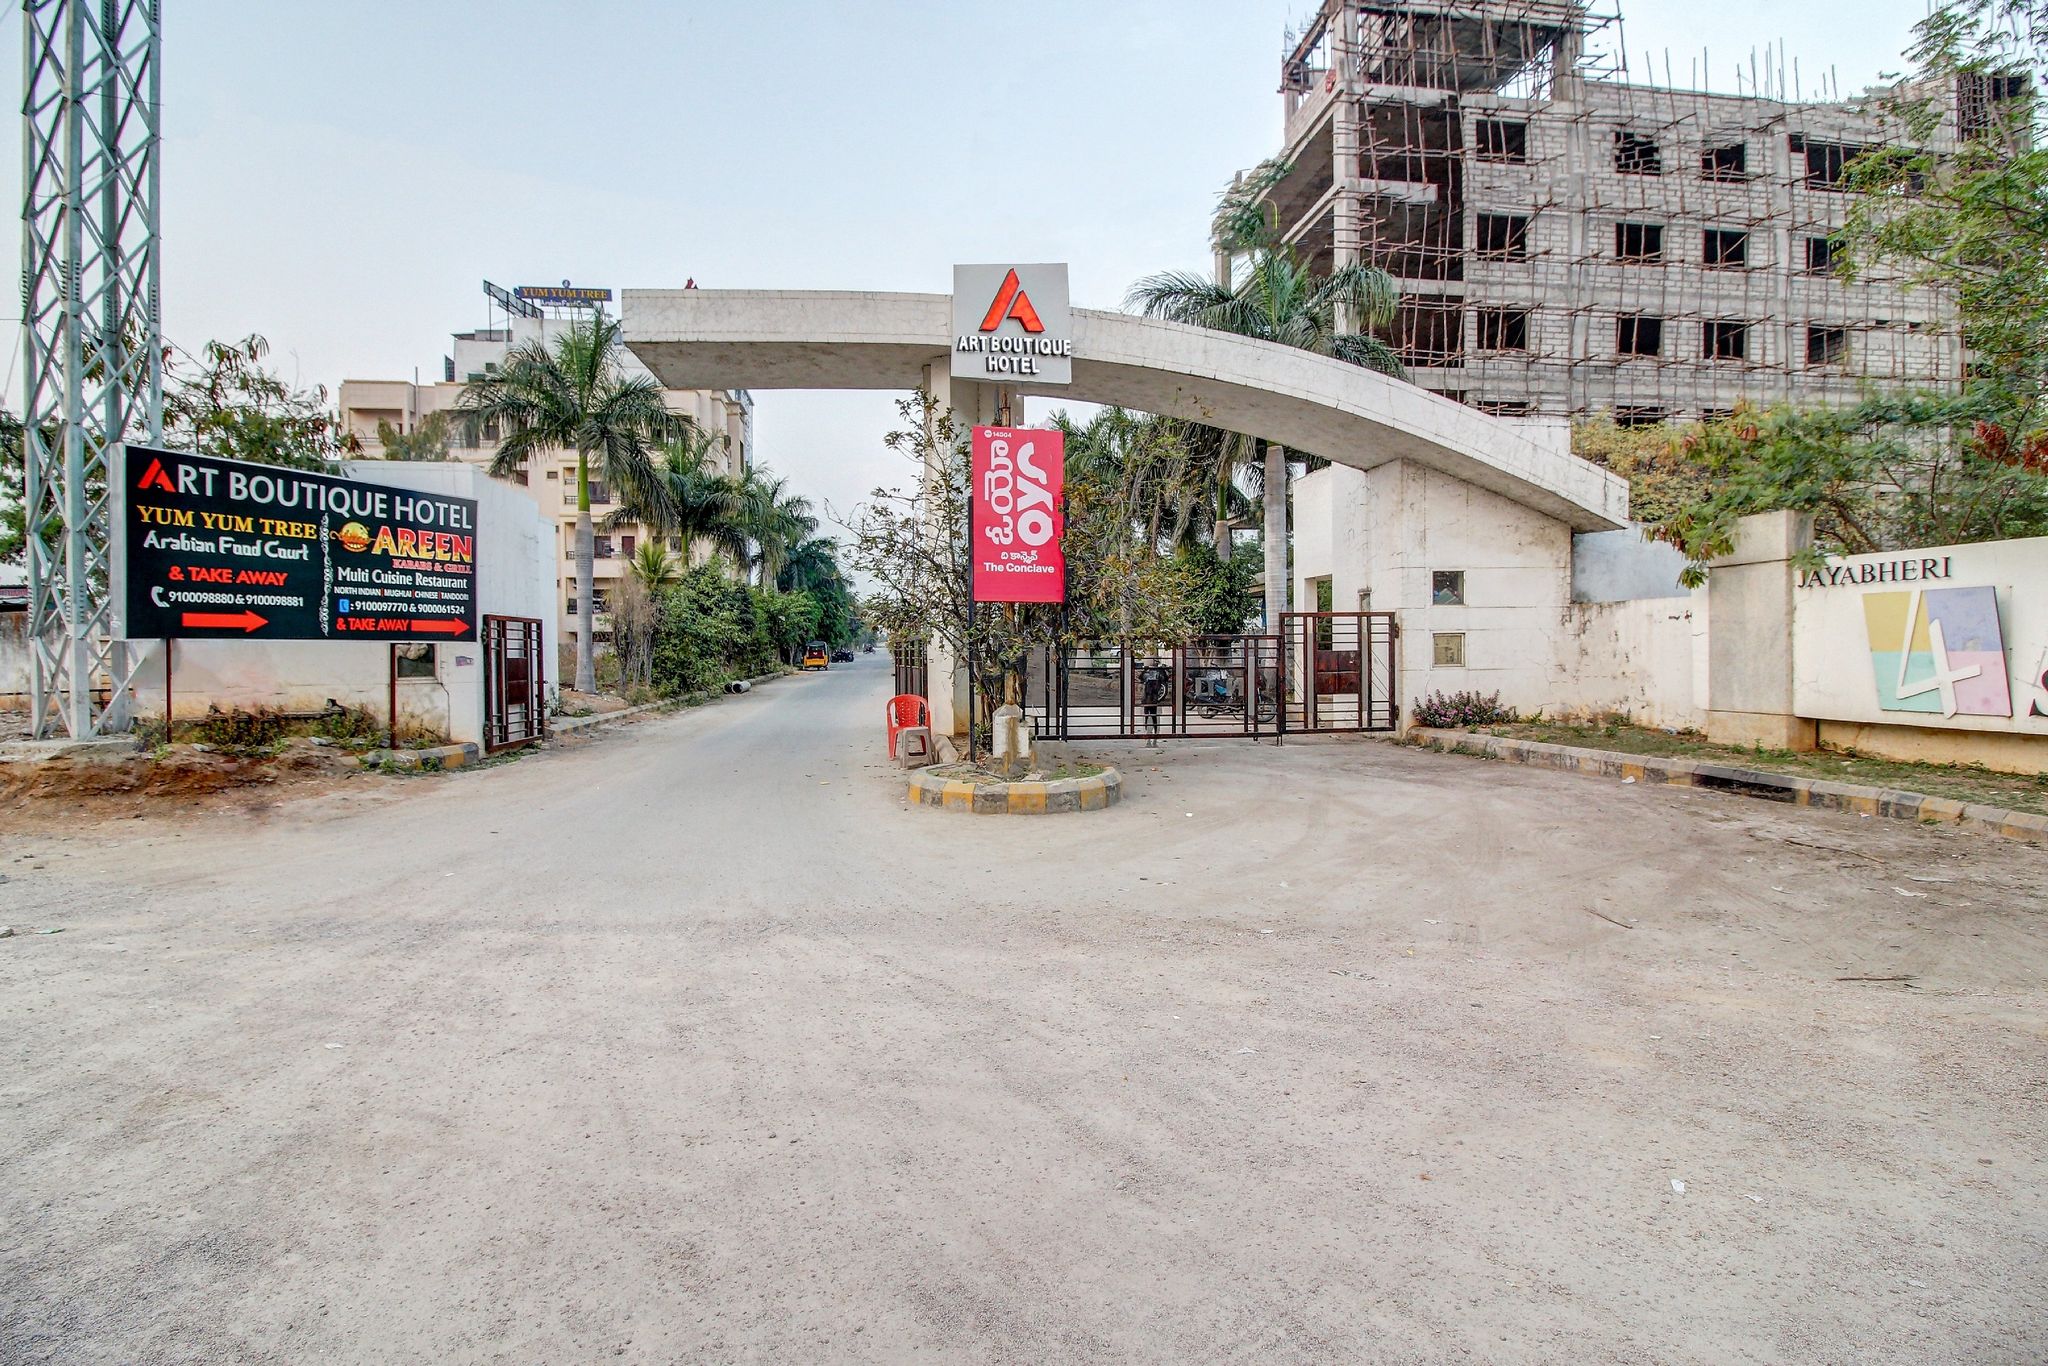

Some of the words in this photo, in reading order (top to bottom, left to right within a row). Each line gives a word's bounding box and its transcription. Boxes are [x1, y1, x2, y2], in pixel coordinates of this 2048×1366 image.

[522, 287, 548, 297] YUM
[550, 288, 577, 298] YUM
[578, 289, 607, 299] TREE
[957, 335, 987, 352] ART
[990, 337, 1071, 356] BOUTIQUE
[986, 355, 1040, 374] HOTEL
[137, 457, 219, 496] ART
[229, 471, 387, 518] BOUTIQUE
[395, 495, 473, 529] HOTEL
[136, 505, 195, 527] YUM
[200, 511, 254, 533] YUM
[259, 518, 317, 539] TREE
[144, 530, 215, 553] Arabian
[219, 535, 262, 557] Food
[264, 540, 309, 561] Court
[371, 525, 473, 563] AREEN
[168, 565, 184, 581] &
[188, 567, 233, 583] TAKE
[235, 570, 288, 586] AWAY
[392, 559, 432, 571] KABABS
[433, 564, 443, 572] &
[444, 564, 473, 574] GRILL
[984, 562, 1004, 572] The
[1006, 563, 1055, 573] Conclave
[1798, 557, 1951, 588] JAYABHERI
[337, 566, 369, 583] Multi
[372, 569, 413, 586] Cuisine
[415, 572, 468, 589] Restaurant
[168, 591, 234, 604] 9100098880
[235, 595, 245, 605] &
[246, 595, 304, 607] 9100098881
[334, 586, 358, 595] NORTH
[358, 588, 381, 597] INDIAN
[414, 591, 438, 599] CHINESE
[355, 601, 408, 612] 9100097770
[409, 603, 417, 612] &
[417, 603, 465, 614] 9000061524
[336, 617, 346, 631] &
[347, 618, 376, 631] TAKE
[377, 619, 409, 632] AWAY
[1896, 589, 1981, 719] 4
